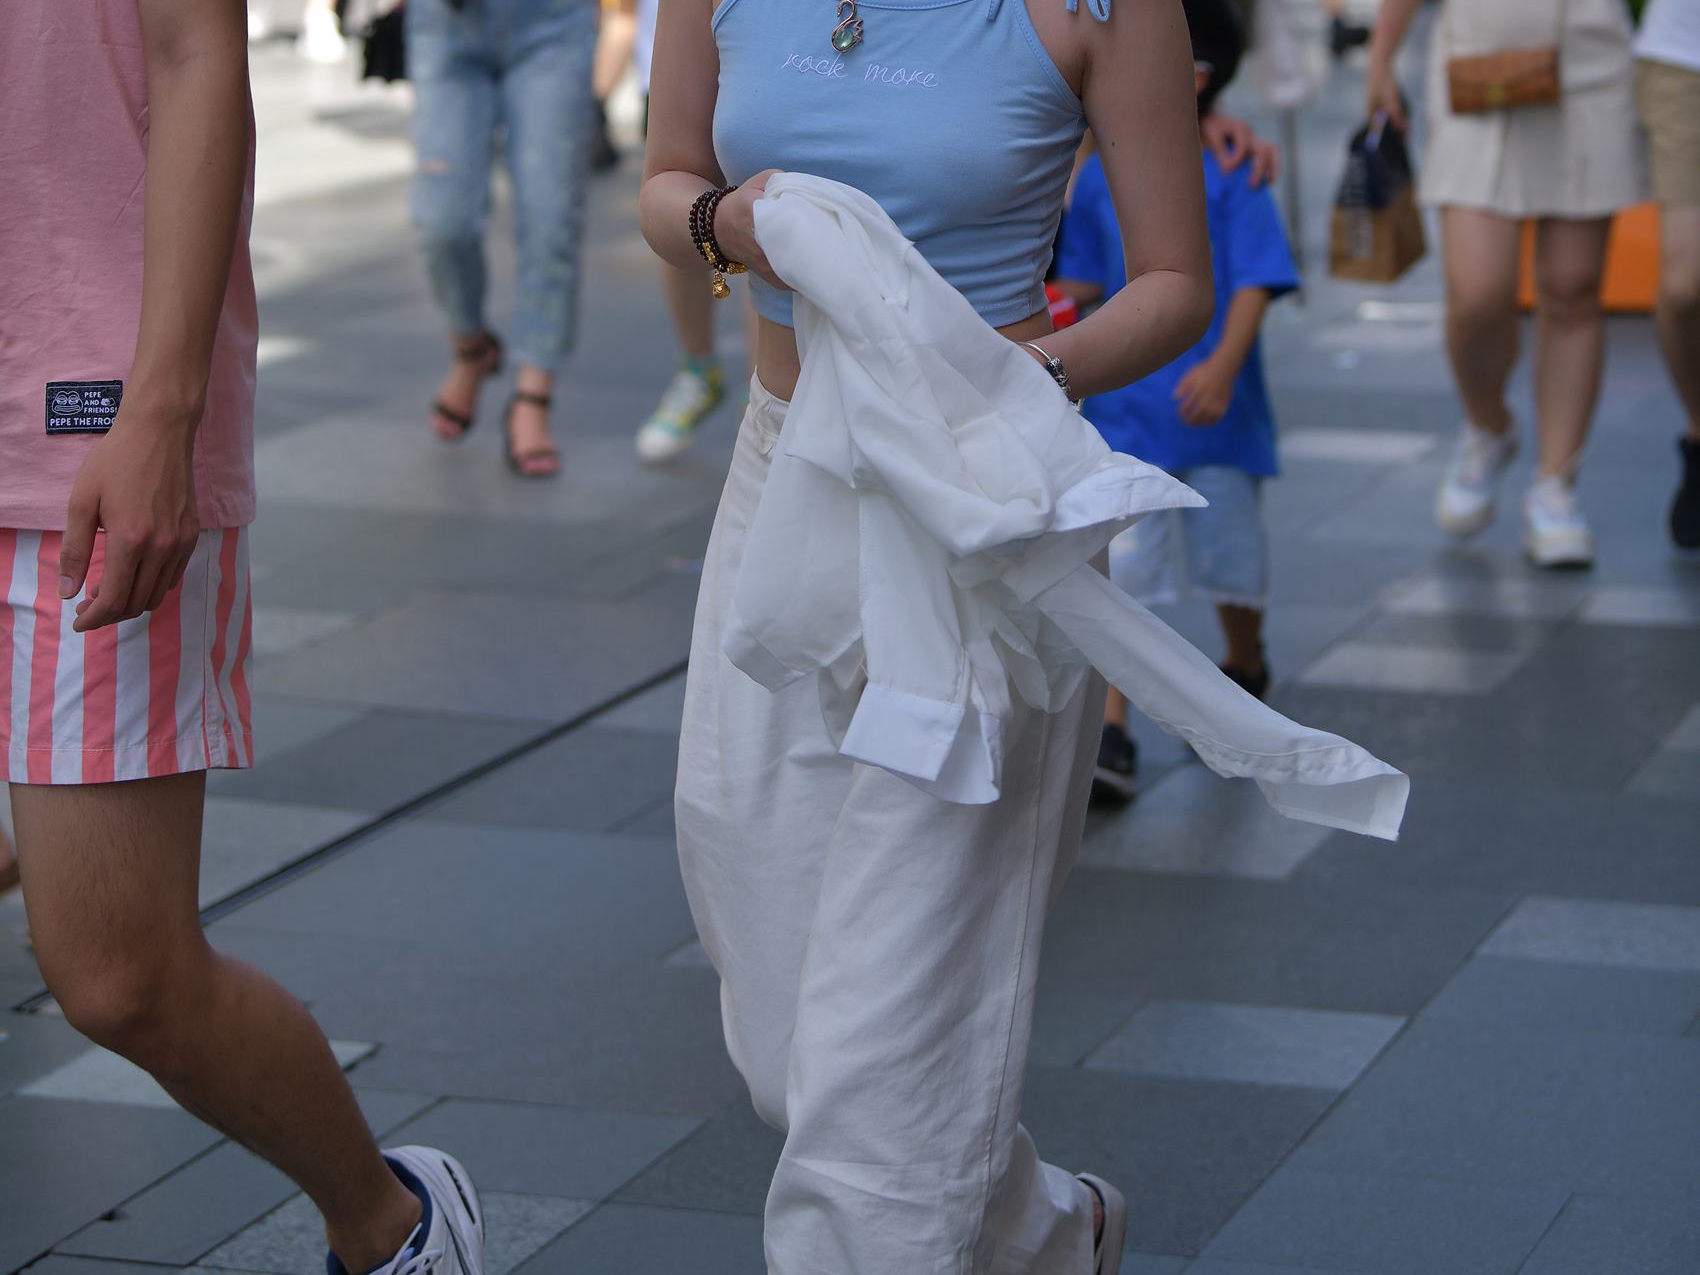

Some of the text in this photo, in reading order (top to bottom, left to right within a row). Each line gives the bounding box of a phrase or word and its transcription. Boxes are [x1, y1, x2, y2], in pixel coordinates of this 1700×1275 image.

[83, 406, 118, 414] FRIENDS!
[49, 418, 72, 427] PEPE
[73, 417, 91, 426] THE
